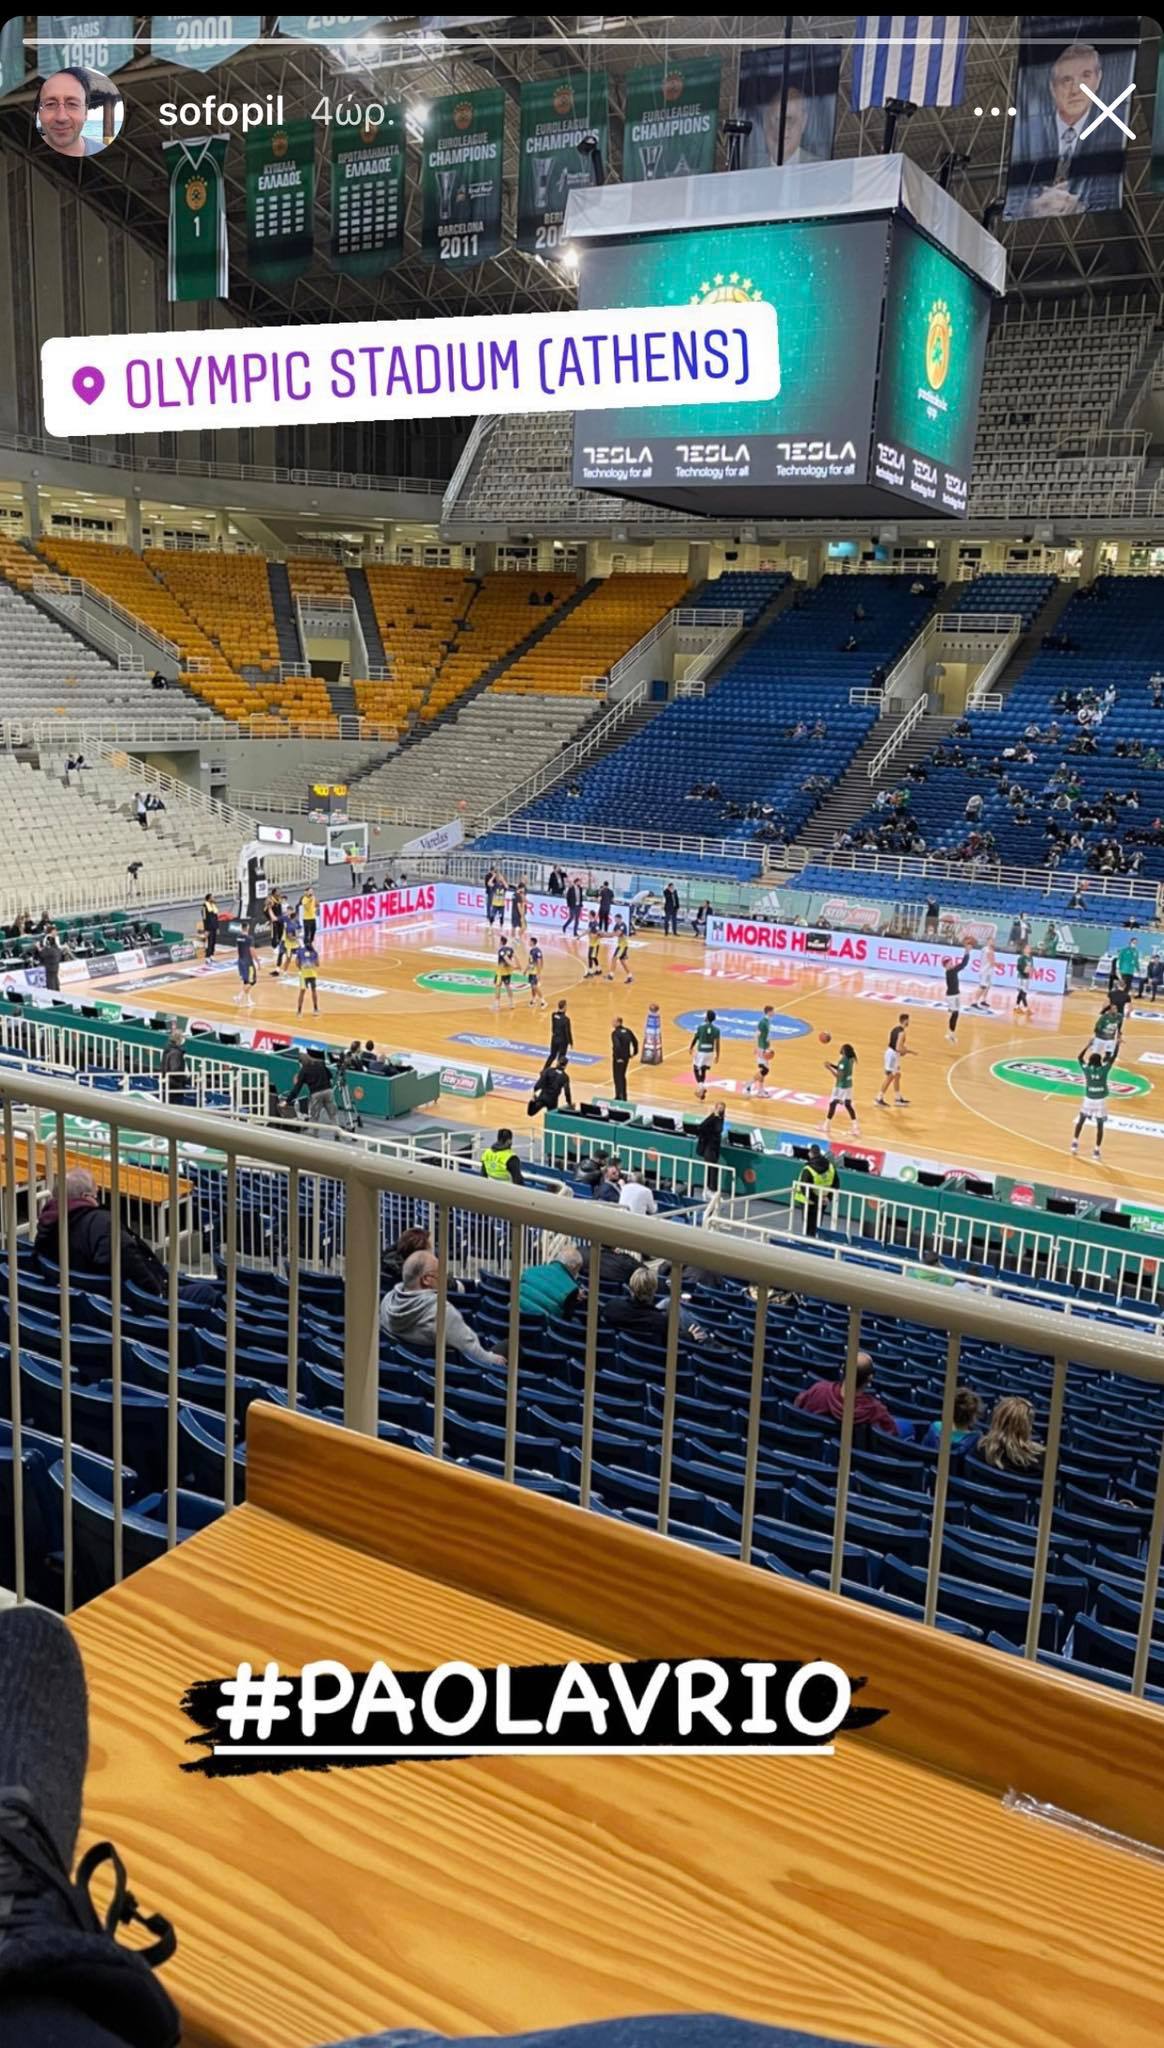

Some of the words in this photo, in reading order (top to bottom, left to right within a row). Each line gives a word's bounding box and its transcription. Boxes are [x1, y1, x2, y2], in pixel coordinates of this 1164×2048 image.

[71, 22, 100, 38] PARIS
[61, 37, 109, 68] 1996
[642, 103, 701, 123] EUROLEAGUE
[632, 115, 711, 143] CHAMPIONS
[437, 132, 488, 150] EUROLEAGUE
[429, 143, 497, 168] CHAMPIONS
[192, 216, 201, 238] 1
[438, 221, 484, 235] BARCELONA
[440, 234, 479, 260] 2011
[583, 446, 653, 464] TESLA
[676, 444, 751, 463] TESLA
[776, 441, 857, 461] TESLA
[583, 467, 629, 481] Technology
[629, 467, 642, 478] for
[642, 467, 653, 478] all
[676, 466, 725, 480] Technology
[725, 466, 738, 477] for
[738, 465, 750, 477] all
[776, 464, 829, 479] Technology
[829, 464, 843, 475] for
[843, 463, 855, 475] all
[323, 896, 376, 928] MORIS
[378, 886, 436, 921] HELLAS
[726, 922, 787, 950] MORIS
[791, 932, 867, 960] HLAS
[971, 959, 1057, 983] SSTMS
